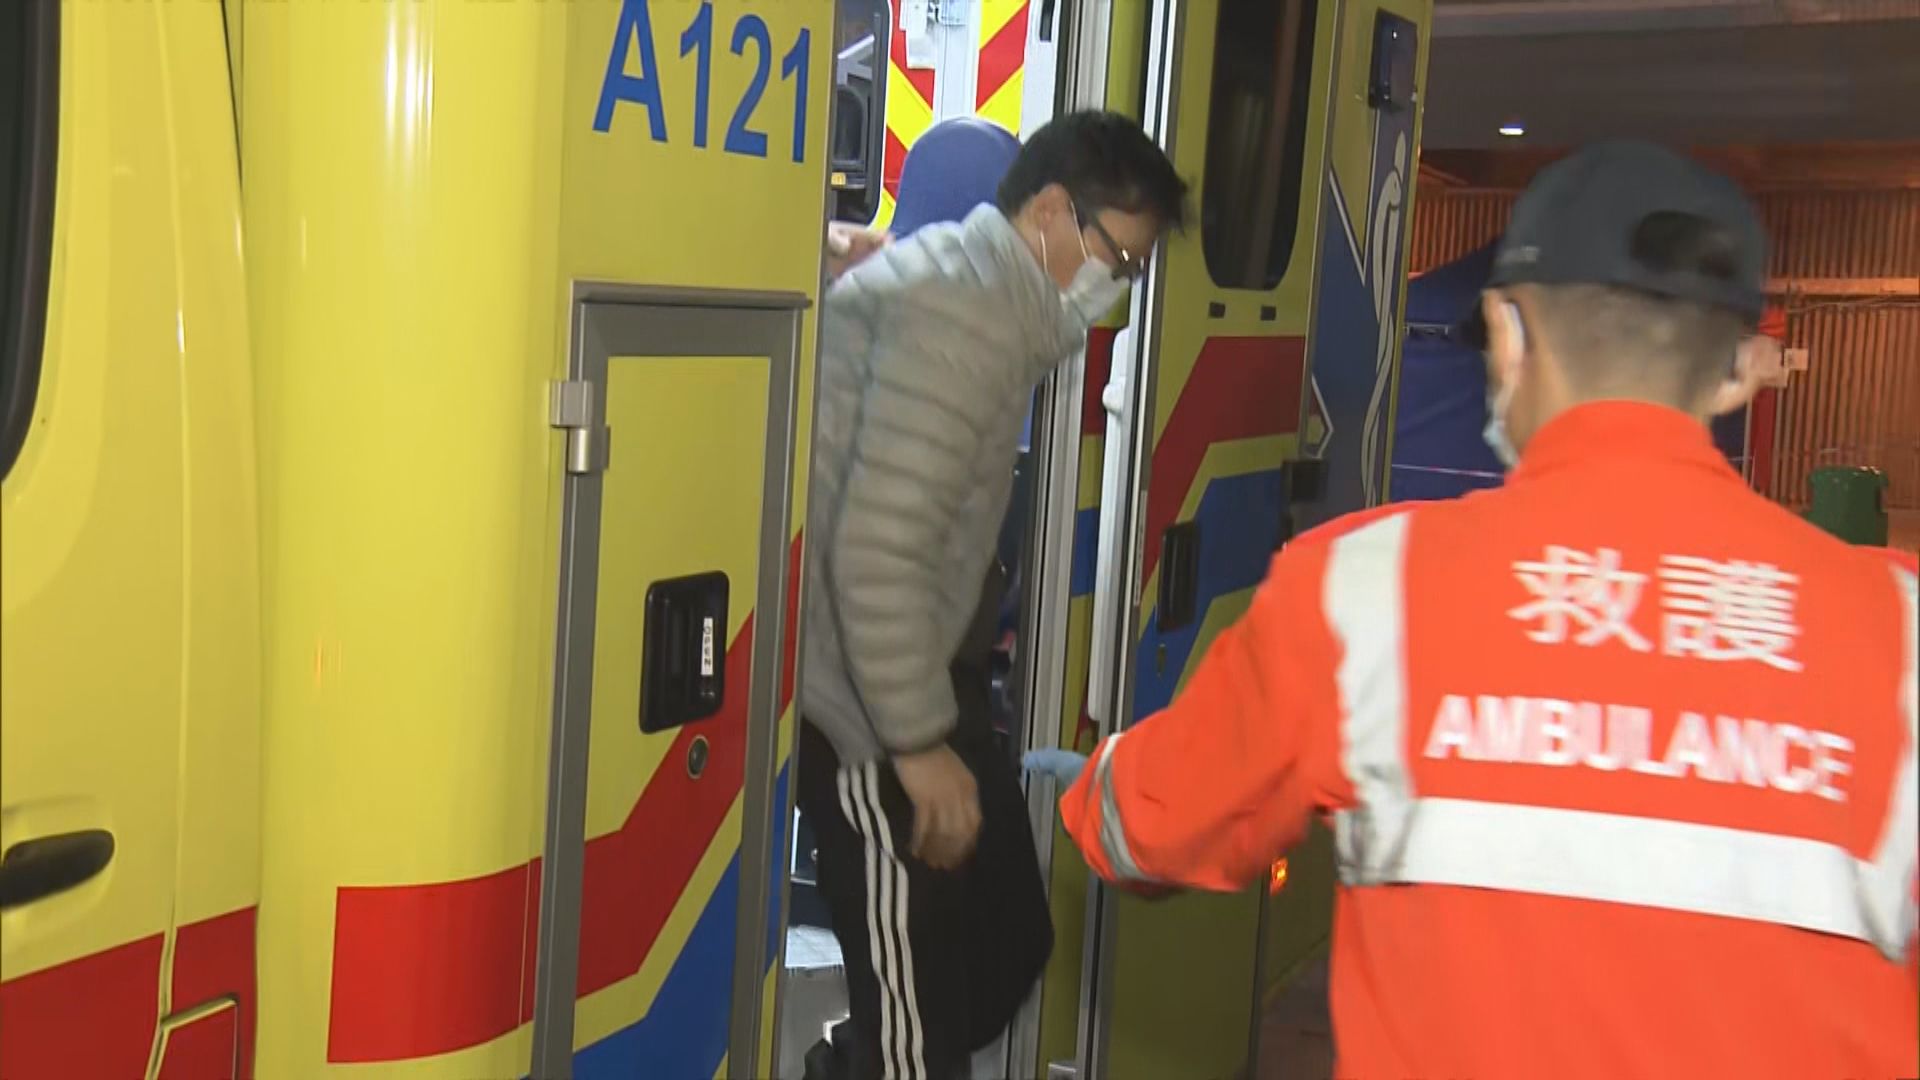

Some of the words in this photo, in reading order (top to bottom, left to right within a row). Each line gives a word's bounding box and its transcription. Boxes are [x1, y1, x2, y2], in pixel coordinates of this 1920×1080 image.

[592, 0, 811, 164] A121
[703, 625, 712, 666] OPEN
[1506, 544, 1804, 673] 救護
[1423, 694, 1855, 802] AMBULANCE
